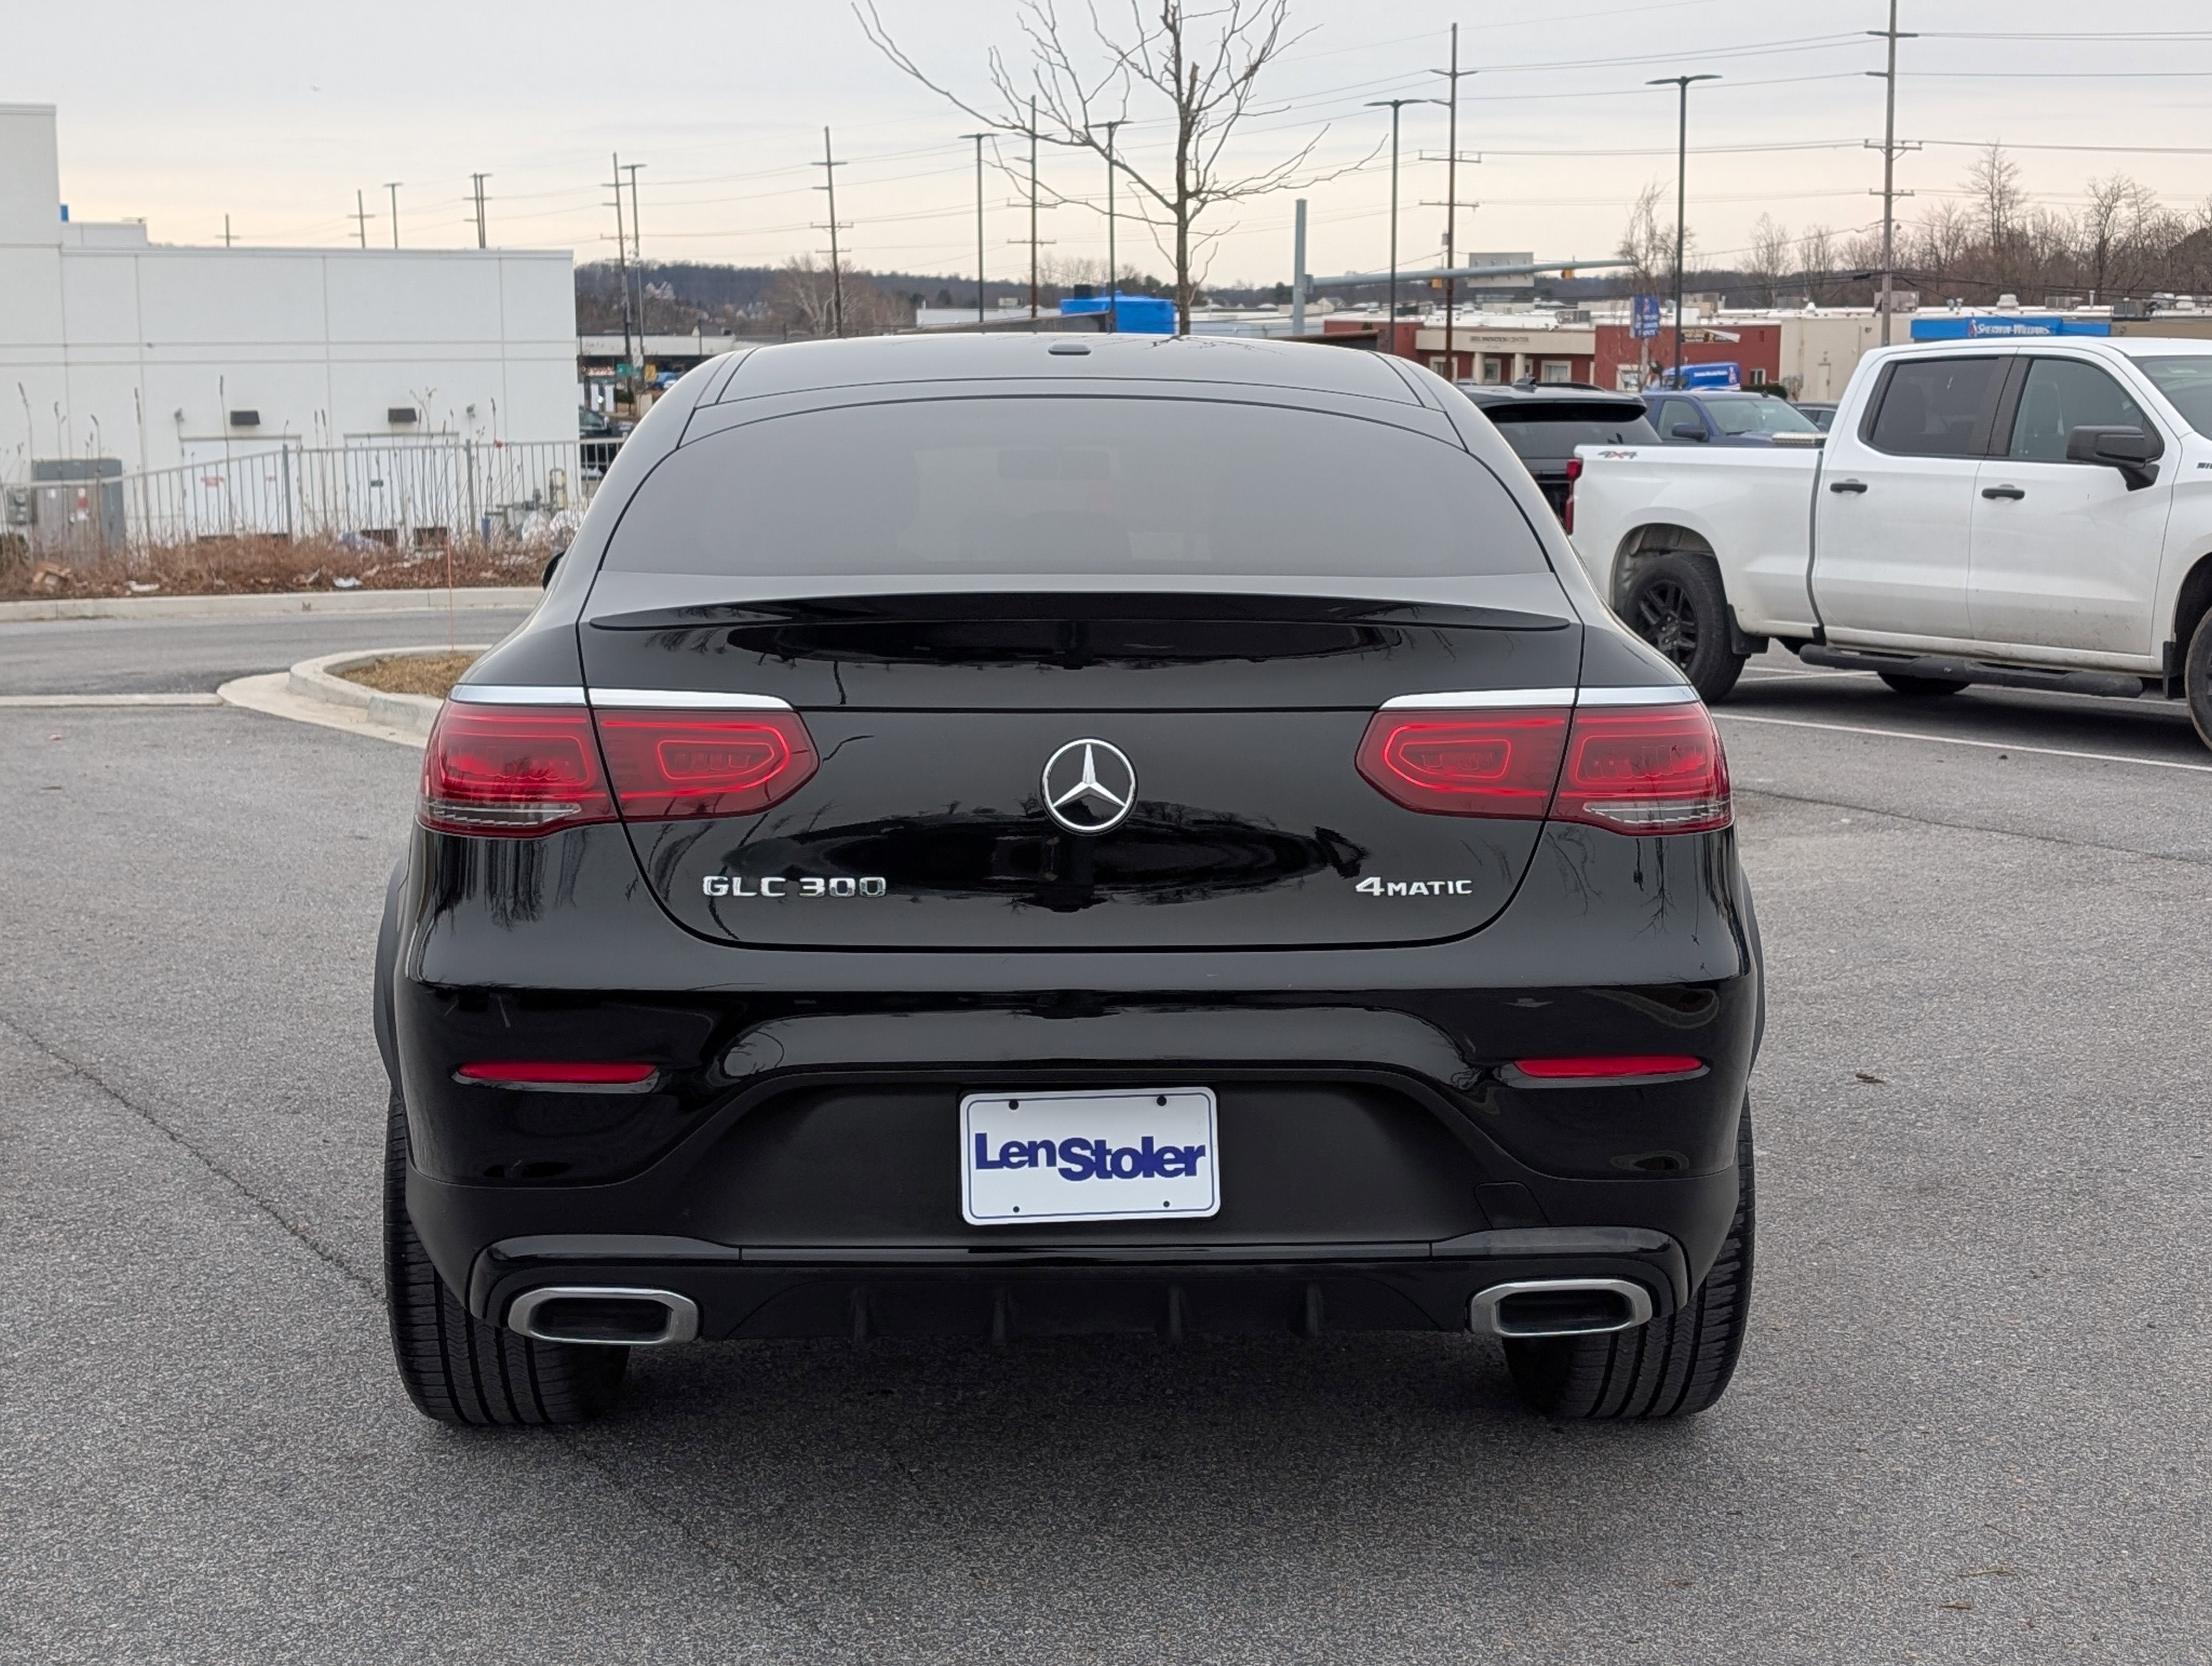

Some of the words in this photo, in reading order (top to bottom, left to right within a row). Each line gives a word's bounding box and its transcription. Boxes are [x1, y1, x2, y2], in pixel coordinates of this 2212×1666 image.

[703, 876, 787, 897] GLC
[799, 876, 886, 897] 300
[1355, 876, 1473, 896] 4MATIC
